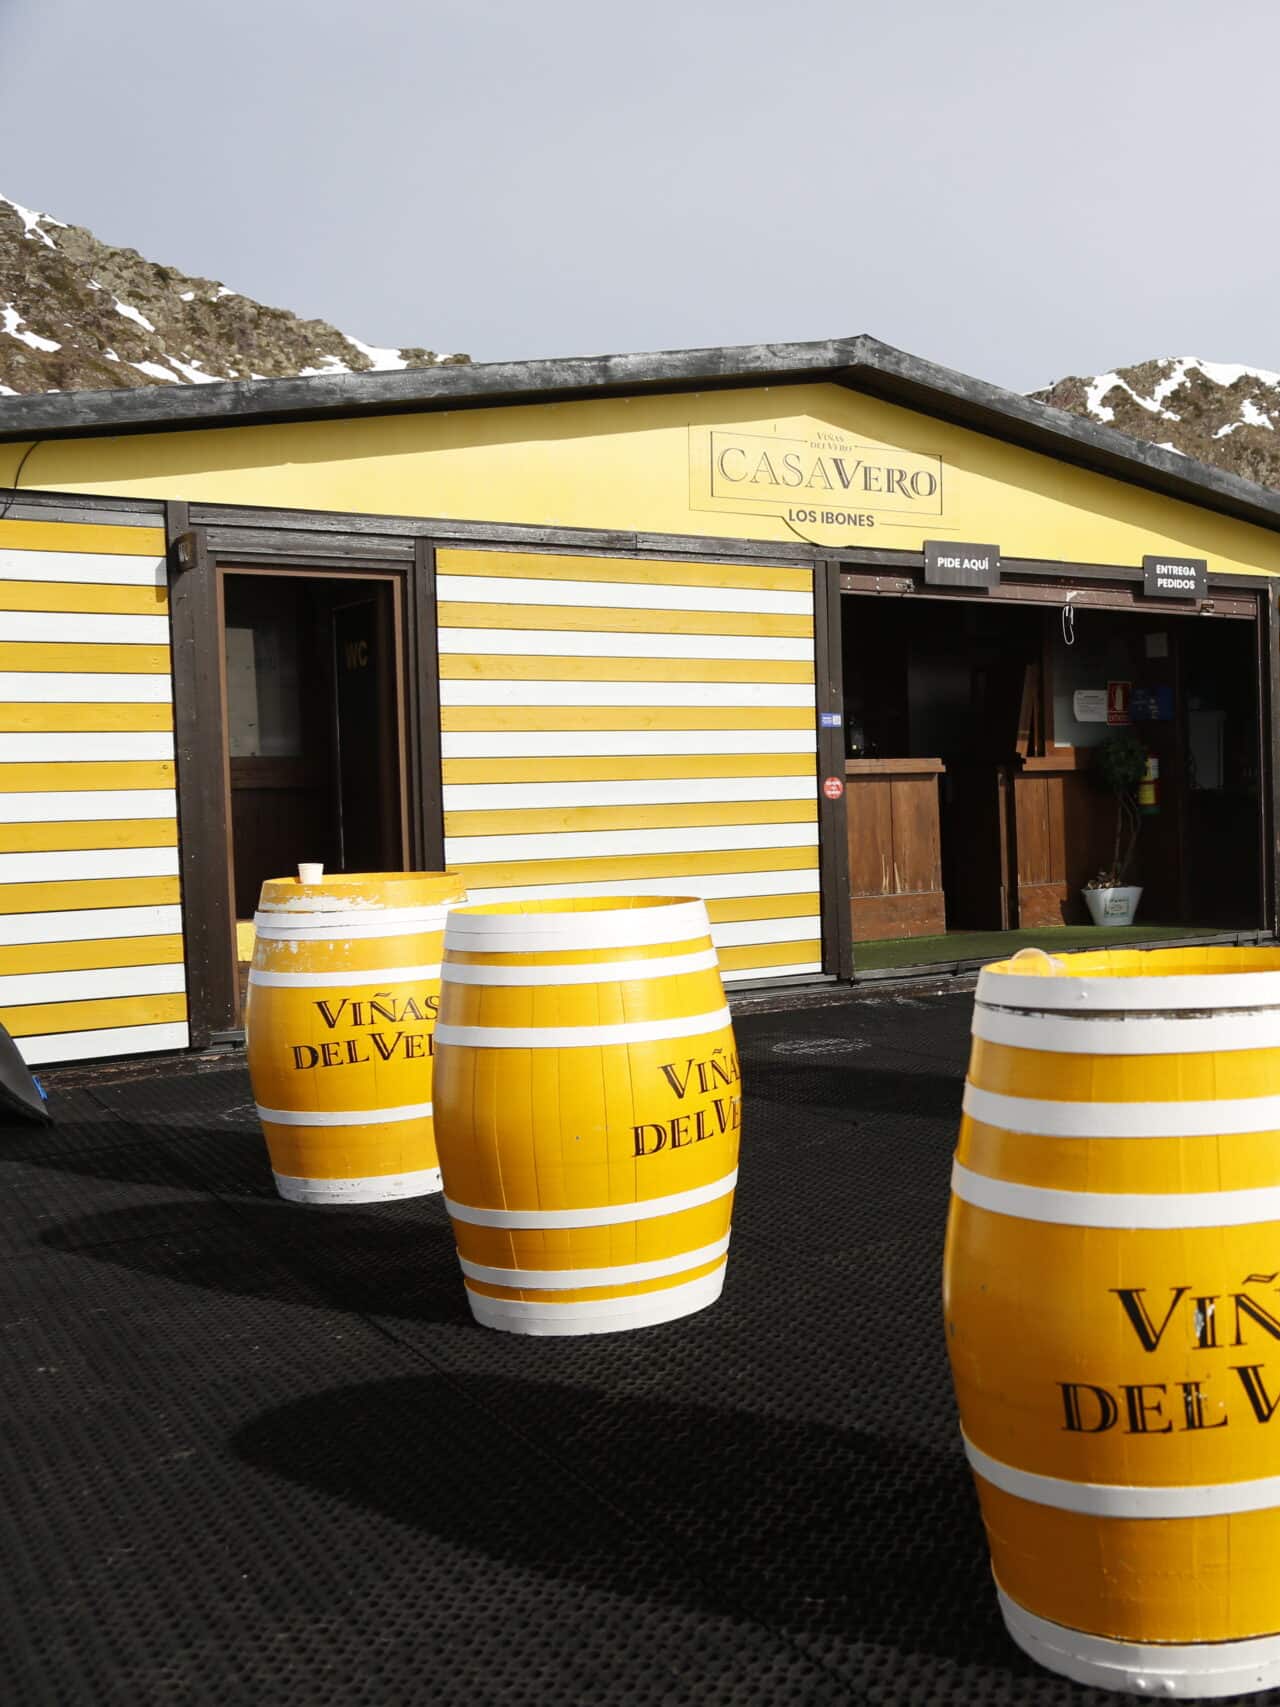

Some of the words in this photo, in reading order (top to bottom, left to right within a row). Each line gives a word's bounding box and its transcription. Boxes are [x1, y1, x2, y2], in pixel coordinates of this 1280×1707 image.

[788, 509, 816, 524] LOS
[821, 511, 875, 527] IBONES
[937, 557, 961, 568] PIDE
[962, 557, 989, 571] AQUÍ
[1155, 564, 1197, 577] ENTREGA
[1157, 578, 1196, 589] PEDIDOS
[344, 640, 369, 671] WC
[312, 992, 441, 1029] VIÑAS
[290, 1039, 370, 1070] DEL
[366, 1031, 435, 1061] VE
[657, 1048, 740, 1100] VIÑA
[630, 1109, 714, 1158] DEL
[1056, 1381, 1229, 1434] DEL
